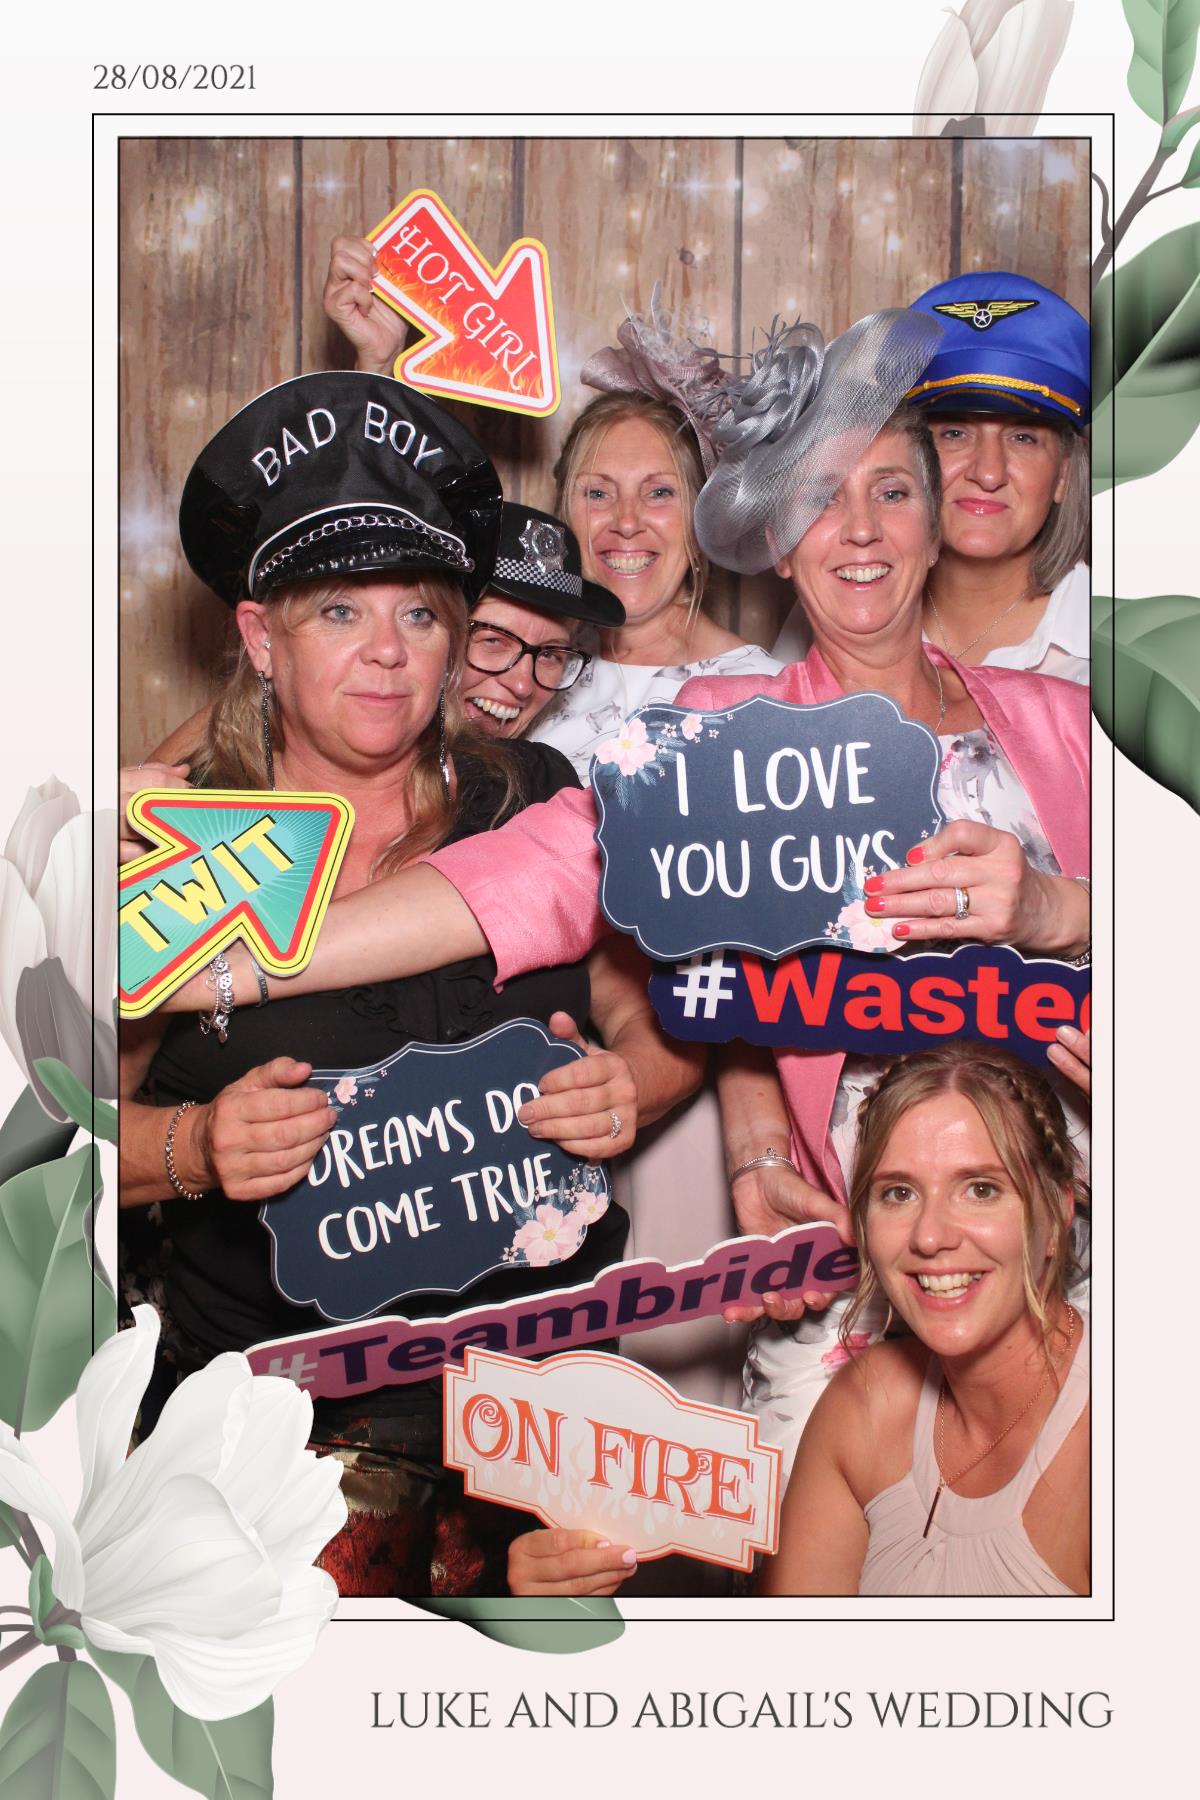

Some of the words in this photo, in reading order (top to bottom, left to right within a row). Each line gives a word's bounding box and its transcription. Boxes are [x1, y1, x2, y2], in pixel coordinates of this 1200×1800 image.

[391, 224, 477, 306] HOT
[461, 301, 538, 392] GIRL
[252, 407, 338, 487] BAD
[363, 401, 444, 471] BOY
[676, 751, 690, 817] I
[733, 741, 876, 814] LOVE
[119, 813, 295, 953] TWIT
[650, 839, 751, 900] YOU
[770, 830, 900, 894] GUYS
[672, 949, 1090, 1042] #Waste
[307, 1099, 476, 1188] DREAMS
[485, 1082, 541, 1134] DO
[318, 1186, 441, 1261] COME
[451, 1152, 559, 1223] TRUE
[461, 1393, 569, 1477] ON
[585, 1417, 757, 1524] FIRE
